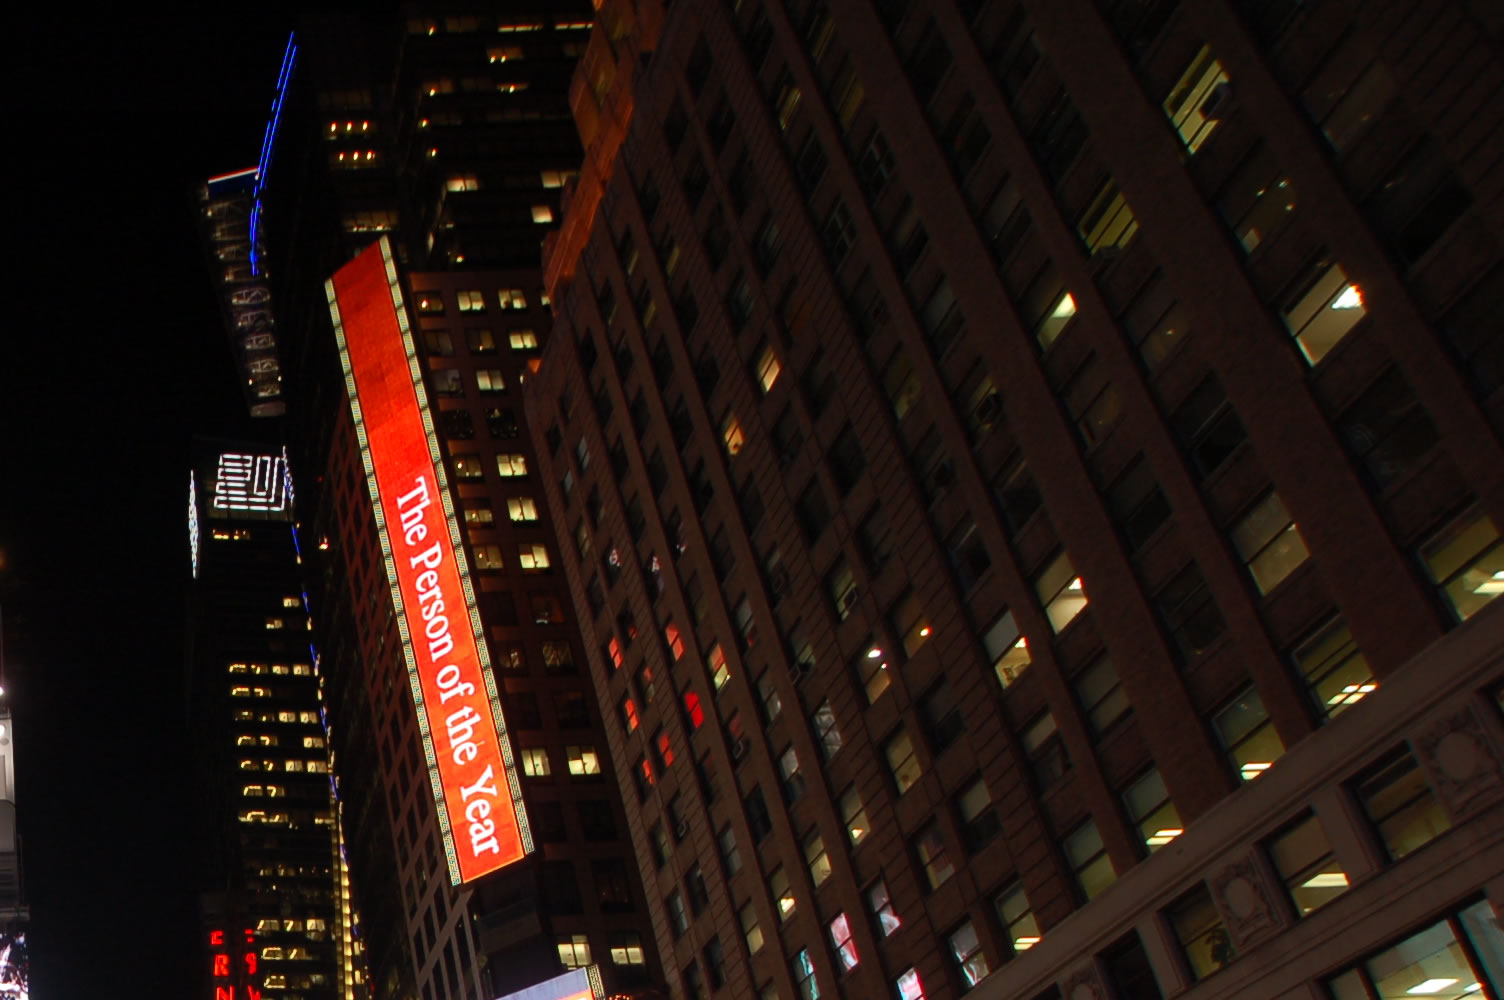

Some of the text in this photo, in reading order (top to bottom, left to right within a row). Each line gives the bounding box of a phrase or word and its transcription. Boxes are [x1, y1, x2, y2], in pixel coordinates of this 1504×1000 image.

[397, 476, 500, 858] The Person of the Year
